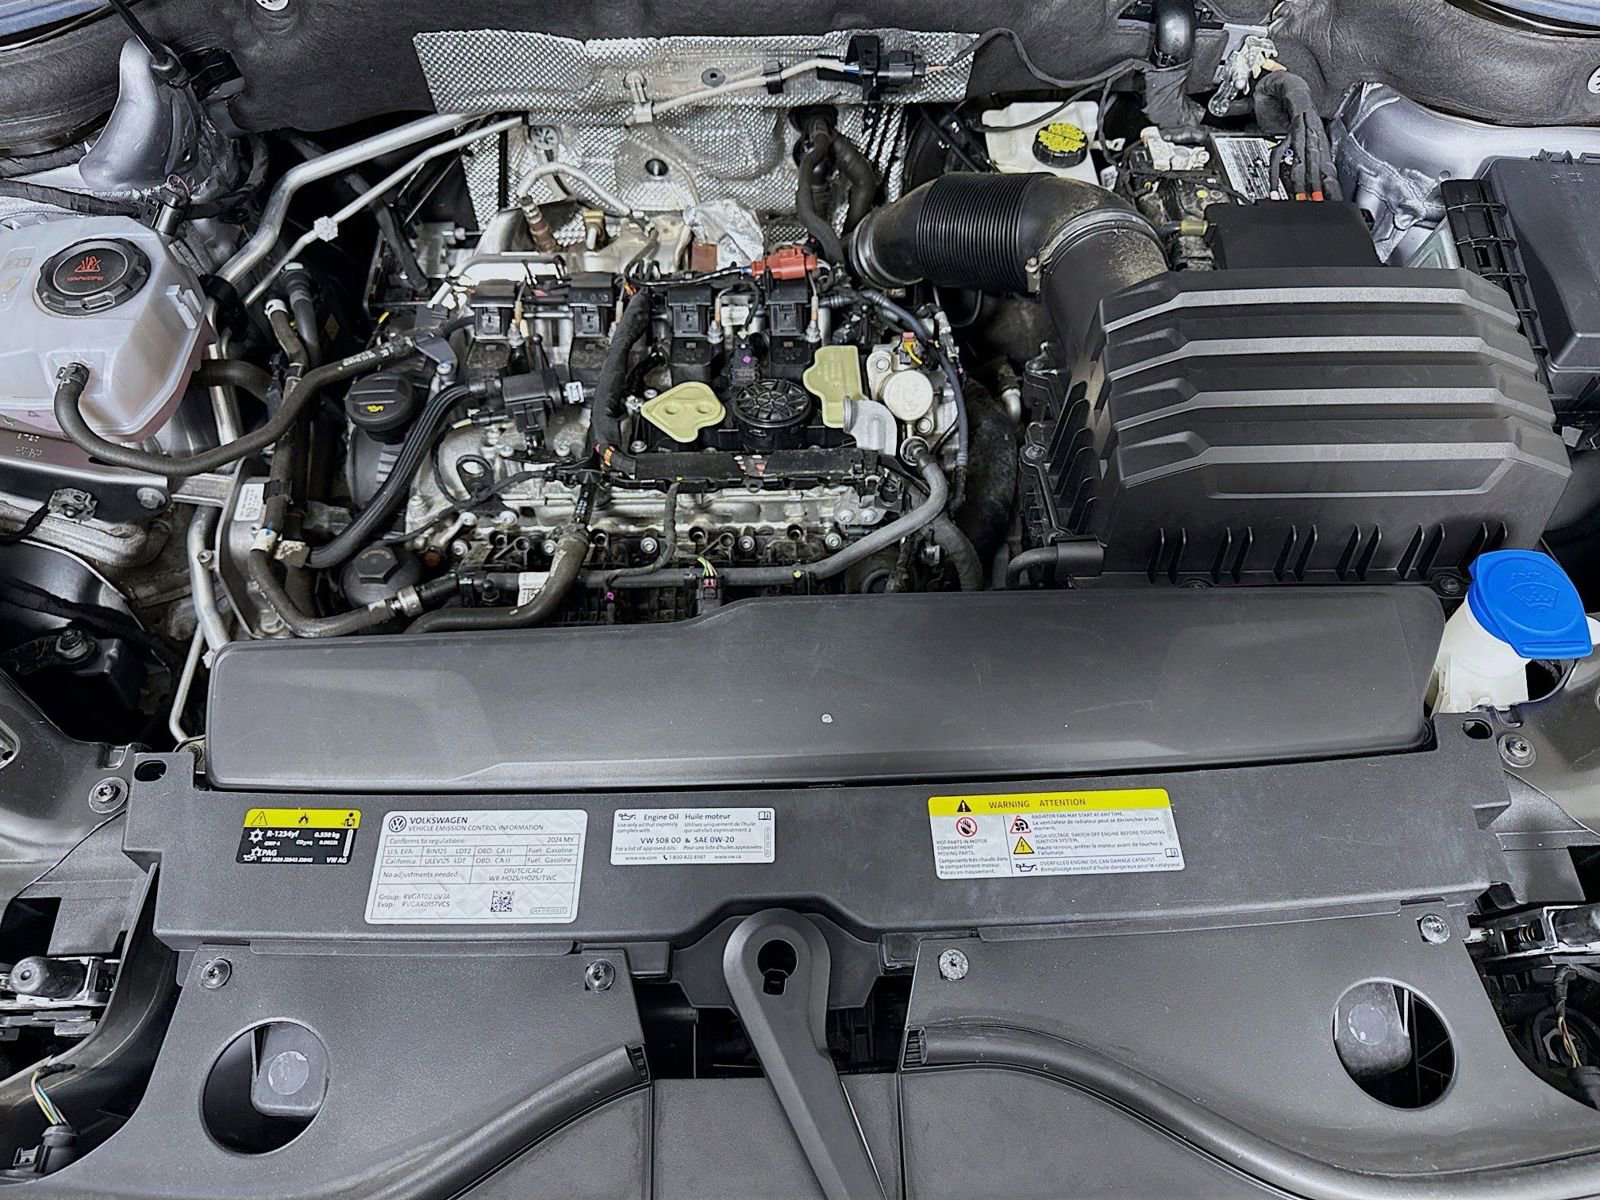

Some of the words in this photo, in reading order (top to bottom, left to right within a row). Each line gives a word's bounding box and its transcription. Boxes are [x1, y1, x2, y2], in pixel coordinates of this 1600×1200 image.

[989, 800, 1030, 809] WARNING
[1040, 799, 1086, 807] ATTENTION
[266, 830, 300, 838] R-1234yf
